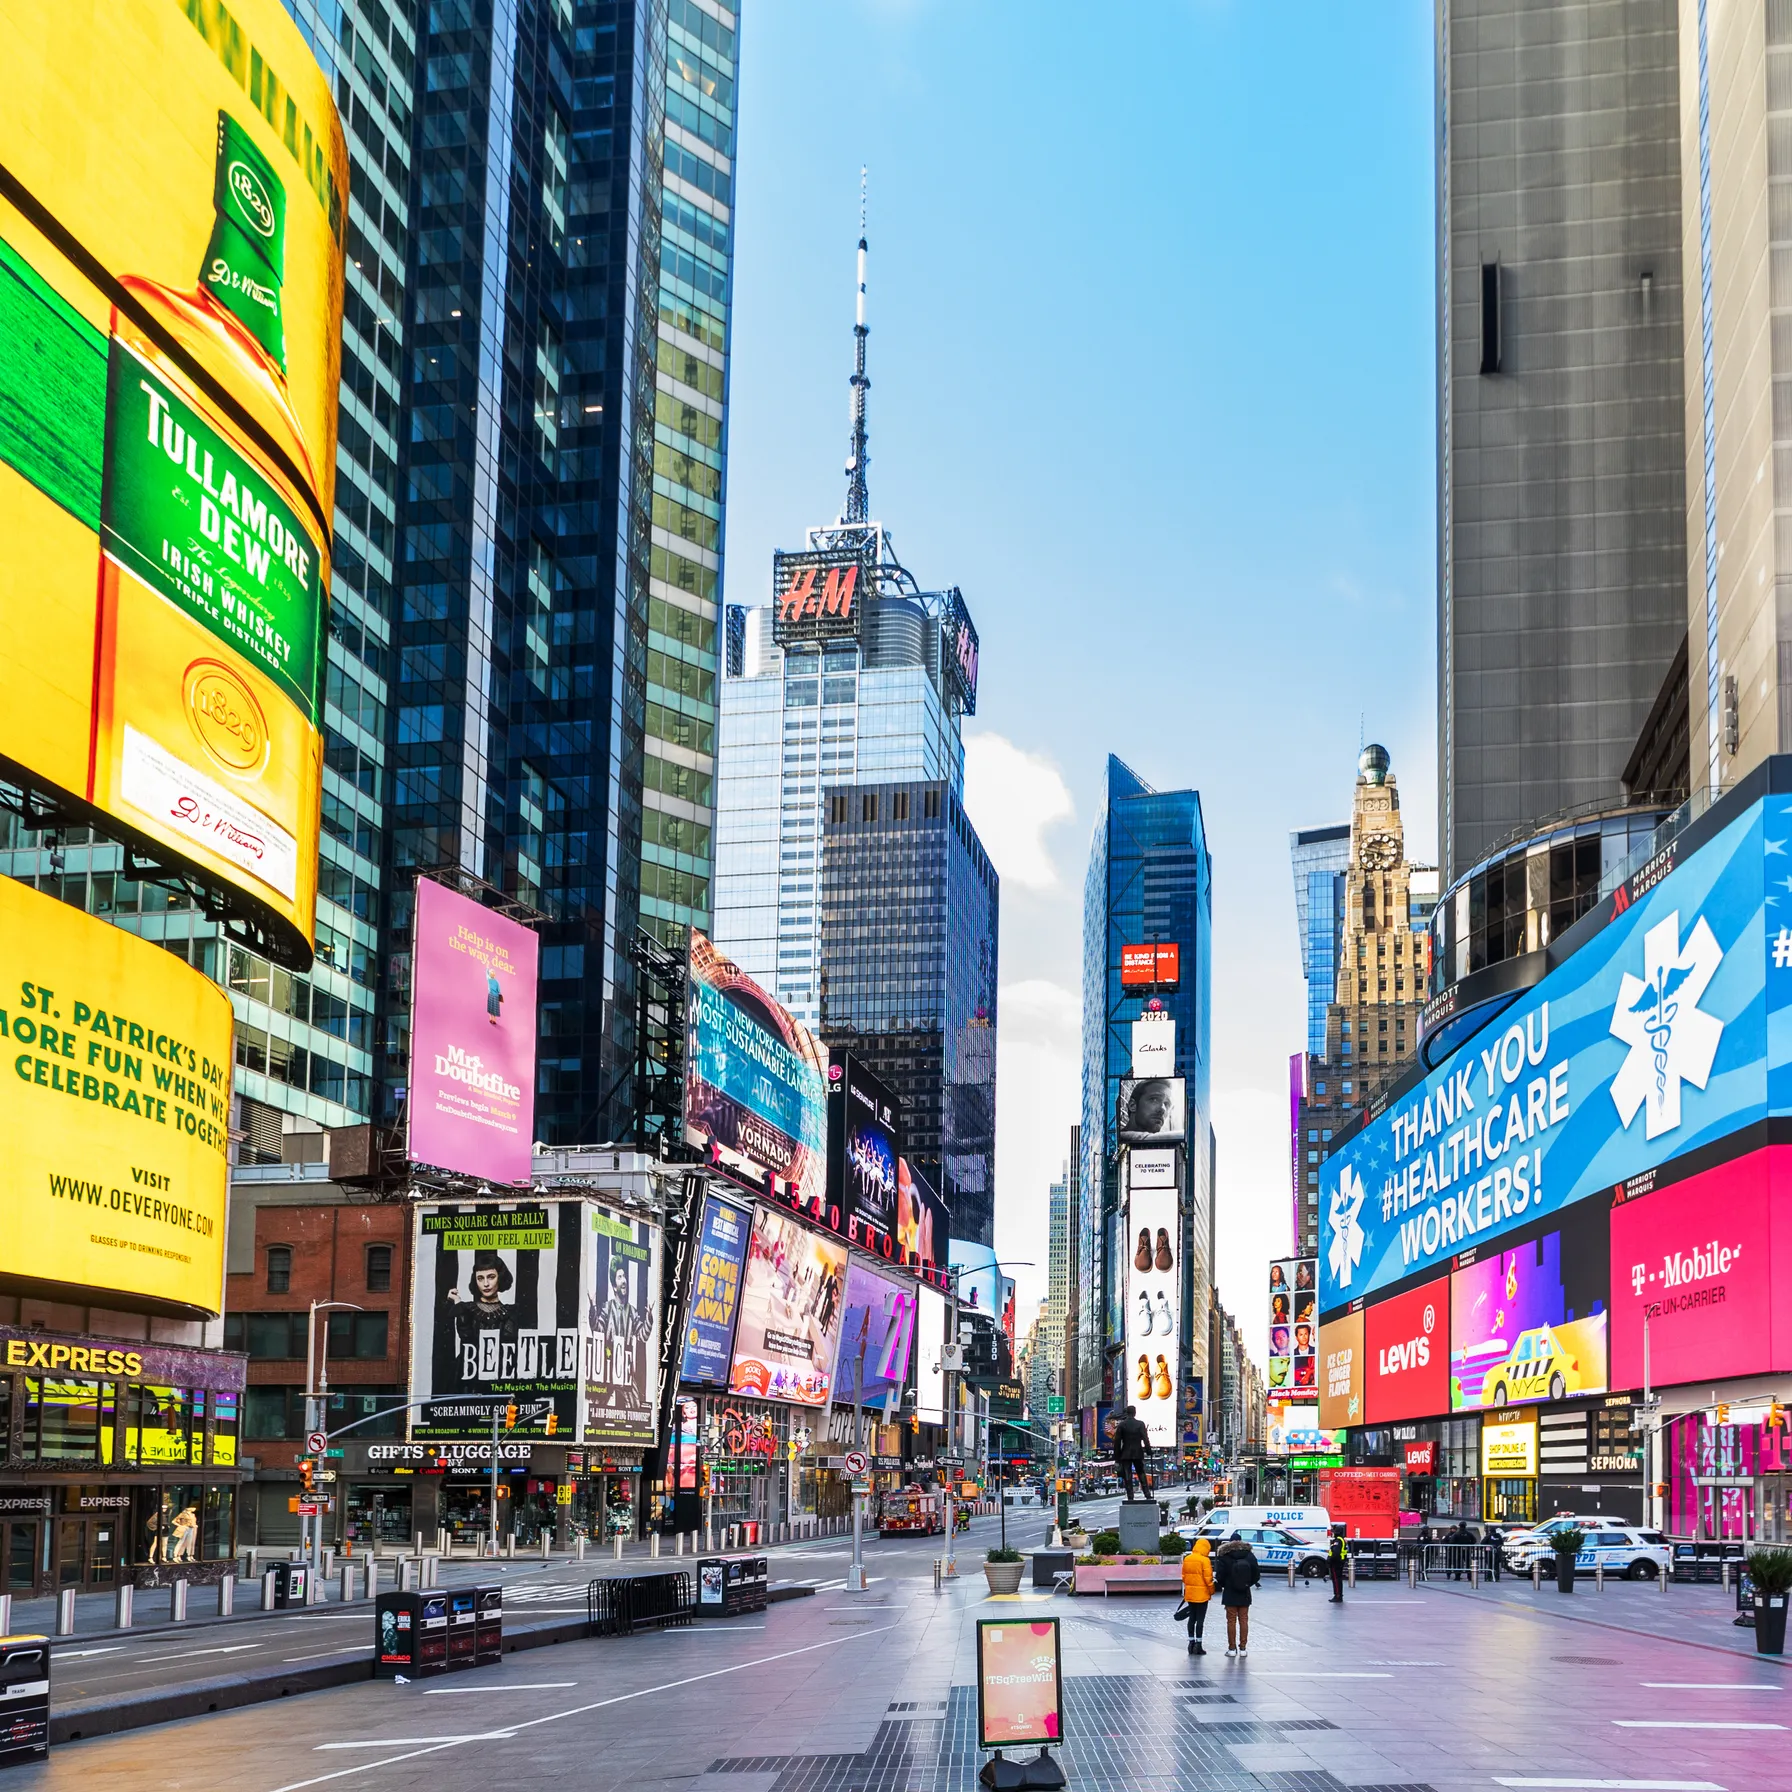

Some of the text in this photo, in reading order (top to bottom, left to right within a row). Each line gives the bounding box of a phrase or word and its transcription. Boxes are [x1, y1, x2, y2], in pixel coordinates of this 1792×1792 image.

[234, 169, 273, 228] 1829
[140, 379, 309, 592] TULLAMORE
[187, 537, 276, 622] The Legendary
[162, 538, 291, 663] IRISH WHISKEY
[778, 566, 858, 622] H&M
[175, 580, 280, 669] TRIPLE DISTILLED
[200, 688, 255, 752] 1829
[1632, 841, 1677, 887] MARRIOTT
[1633, 861, 1673, 901] MARQUIS
[458, 925, 508, 959] Help is on
[448, 936, 516, 976] the way, dear.
[1424, 985, 1459, 1015] MARRIOTT
[1140, 1011, 1168, 1022] 2020
[1424, 1000, 1454, 1030] MARQUIS
[20, 981, 223, 1090] ST. PATRICK'S DAY
[690, 993, 786, 1081] MOST SUSTAINABLE
[734, 1007, 797, 1069] NEW YORK CITY'S
[1139, 1044, 1167, 1052] Clarks
[447, 1044, 484, 1068] Mrs.
[15, 1054, 166, 1124] CELEBRATE
[88, 1040, 223, 1123] FUN WHEN WE
[435, 1054, 520, 1100] Doubtfire
[828, 1083, 842, 1092] LG
[1391, 1000, 1549, 1163] THANK YOU
[439, 1089, 470, 1106] Previews
[470, 1100, 489, 1113] begin
[490, 1106, 512, 1120] March
[1370, 1091, 1388, 1110] MARRIOTT
[1371, 1103, 1386, 1119] MARQUIS
[737, 1121, 791, 1165] VORNADO
[1382, 1059, 1569, 1223] #HEALTHCARE
[746, 1146, 784, 1172] REALTY TRUST
[131, 1166, 171, 1192] VISIT
[558, 1176, 594, 1185] LAMAR
[1627, 1170, 1657, 1189] MARRIOTT
[1627, 1182, 1654, 1199] MARQUIS
[49, 1173, 213, 1238] WWW.OEVERYONE.COM
[1400, 1147, 1543, 1265] WORKERS!
[425, 1211, 545, 1230] TIMES SQUARE CAN REALLY
[90, 1234, 163, 1257] GLASSES UP TO DRINKING
[447, 1232, 552, 1247] MAKE YOU FEEL ALIVE!
[703, 1245, 716, 1255] COME
[715, 1249, 735, 1261] TOGETHER
[1459, 1248, 1477, 1260] MARRIOTT
[1459, 1256, 1475, 1267] MARQUIS
[701, 1253, 738, 1285] COME
[697, 1273, 736, 1305] FROM
[1643, 1285, 1726, 1319] THE UN-CARRIER
[693, 1296, 734, 1326] AWAY
[7, 1340, 142, 1377] EXPRESS
[462, 1328, 577, 1380] BEETLE
[1327, 1353, 1336, 1370] ICE
[1328, 1364, 1351, 1383] GINGER
[491, 1383, 502, 1391] The
[536, 1383, 549, 1391] The
[1271, 1388, 1318, 1398] Black Monday
[1328, 1380, 1351, 1397] FLAVOR
[1511, 1378, 1546, 1398] NYC
[1605, 1396, 1631, 1407] SEPHORA
[368, 1445, 424, 1459] GIFTS
[447, 1458, 464, 1467] NY
[1591, 1456, 1638, 1471] SEPHORA
[81, 1496, 130, 1508] EXPRESS
[1267, 1511, 1304, 1521] POLICE
[1267, 1550, 1294, 1560] NYPD
[1576, 1553, 1596, 1563] YPD
[1030, 1655, 1056, 1666] FREE
